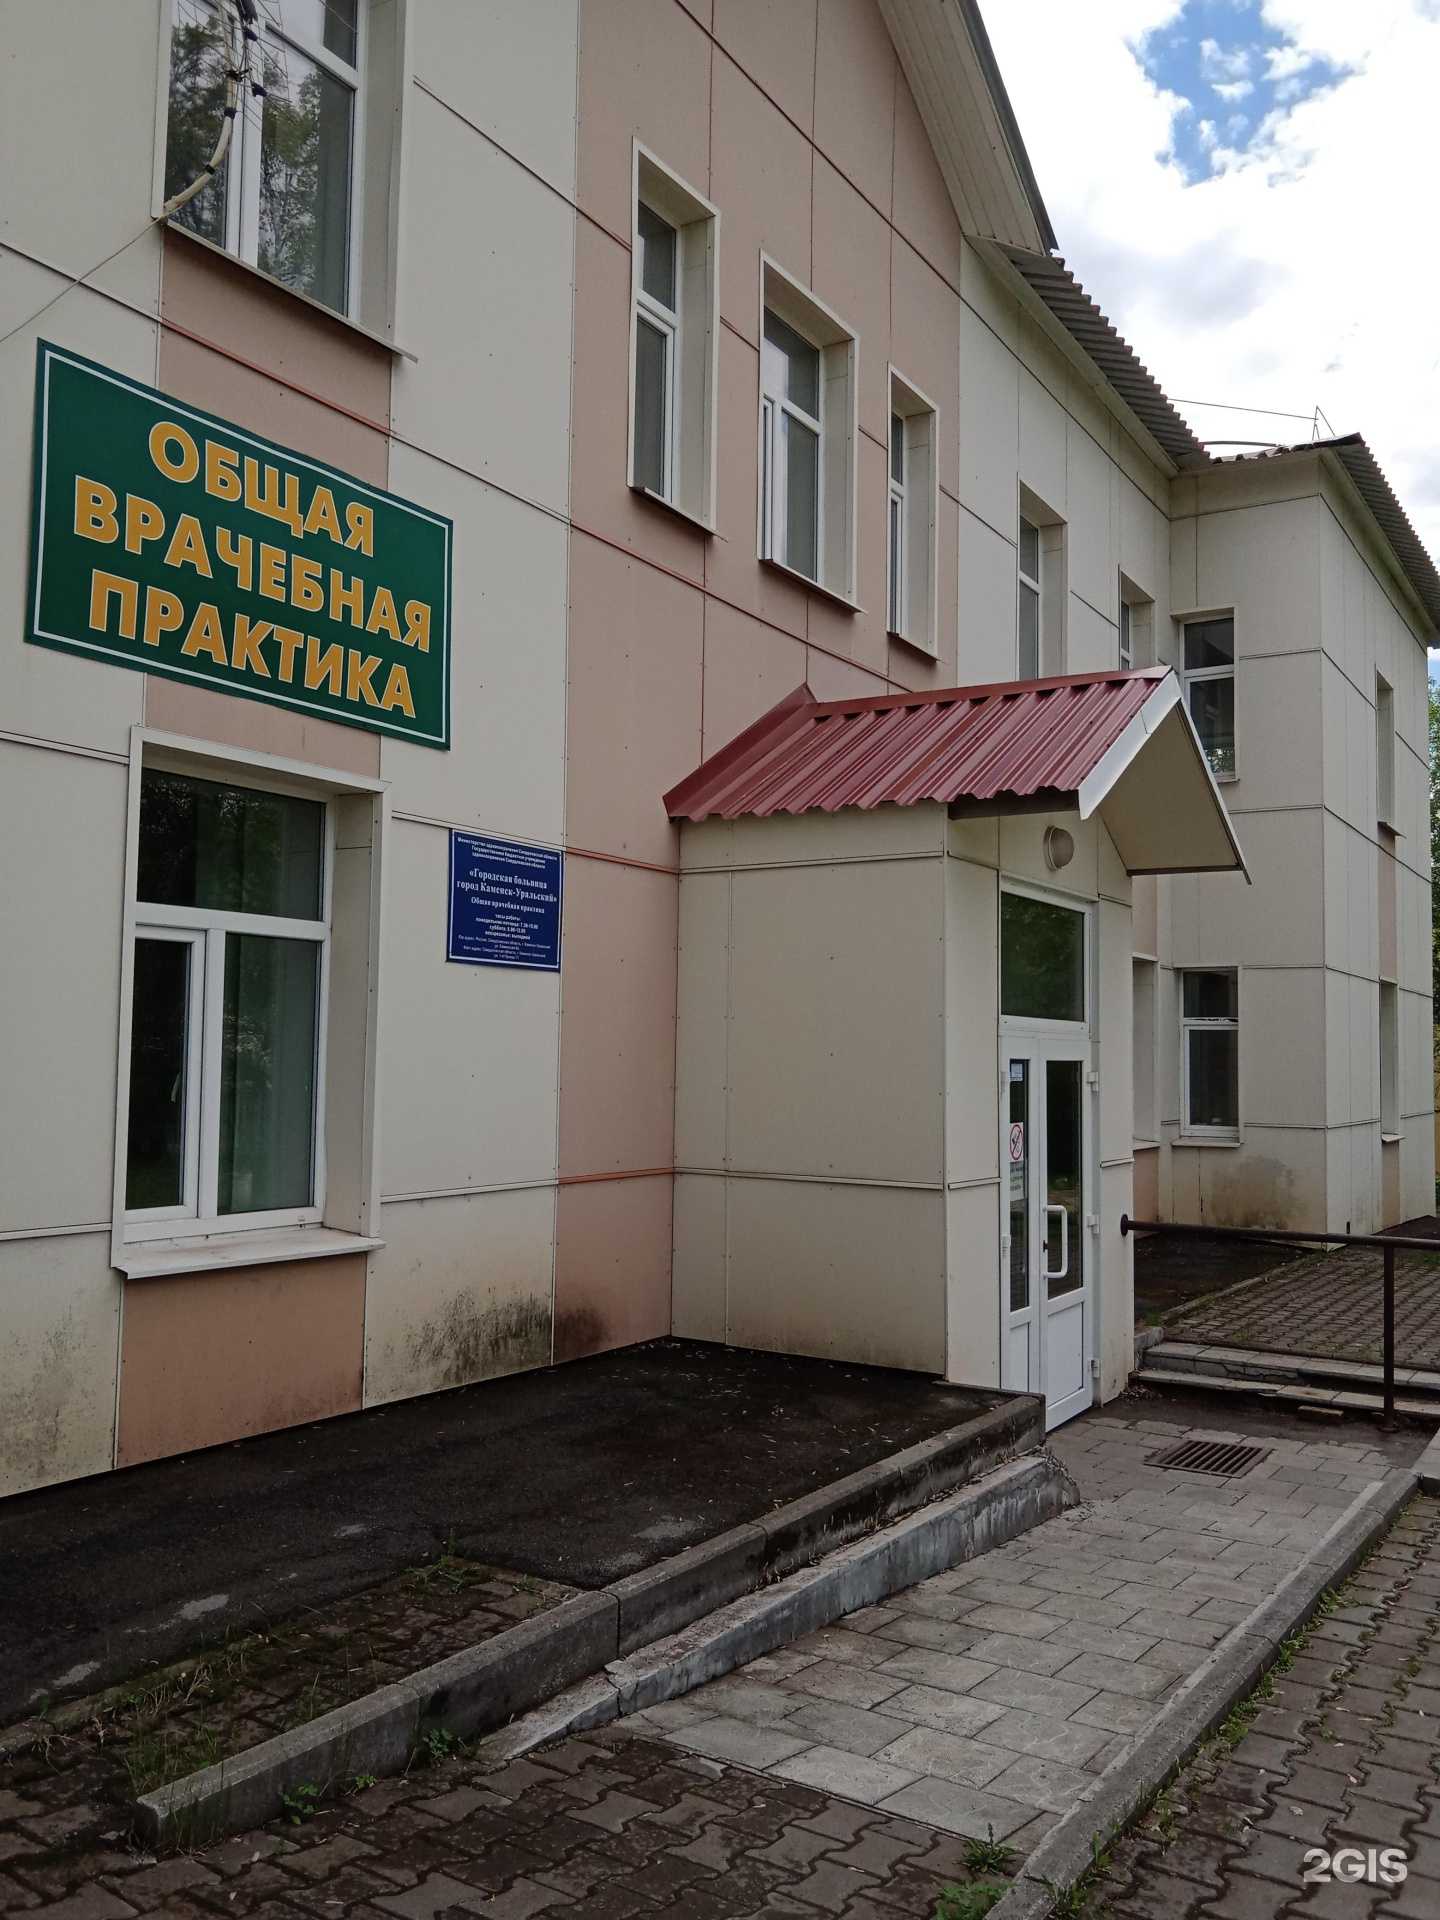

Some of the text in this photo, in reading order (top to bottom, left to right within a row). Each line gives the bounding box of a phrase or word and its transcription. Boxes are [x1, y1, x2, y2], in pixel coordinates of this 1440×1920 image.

[149, 421, 374, 557] ОБЩАЯ
[74, 475, 431, 653] ВРАЧЕБНАЯ
[89, 568, 416, 718] ПРАКТИКА
[456, 880, 479, 892] город
[469, 868, 547, 889] «Городская больница
[471, 897, 545, 914] Общая врачебная практика
